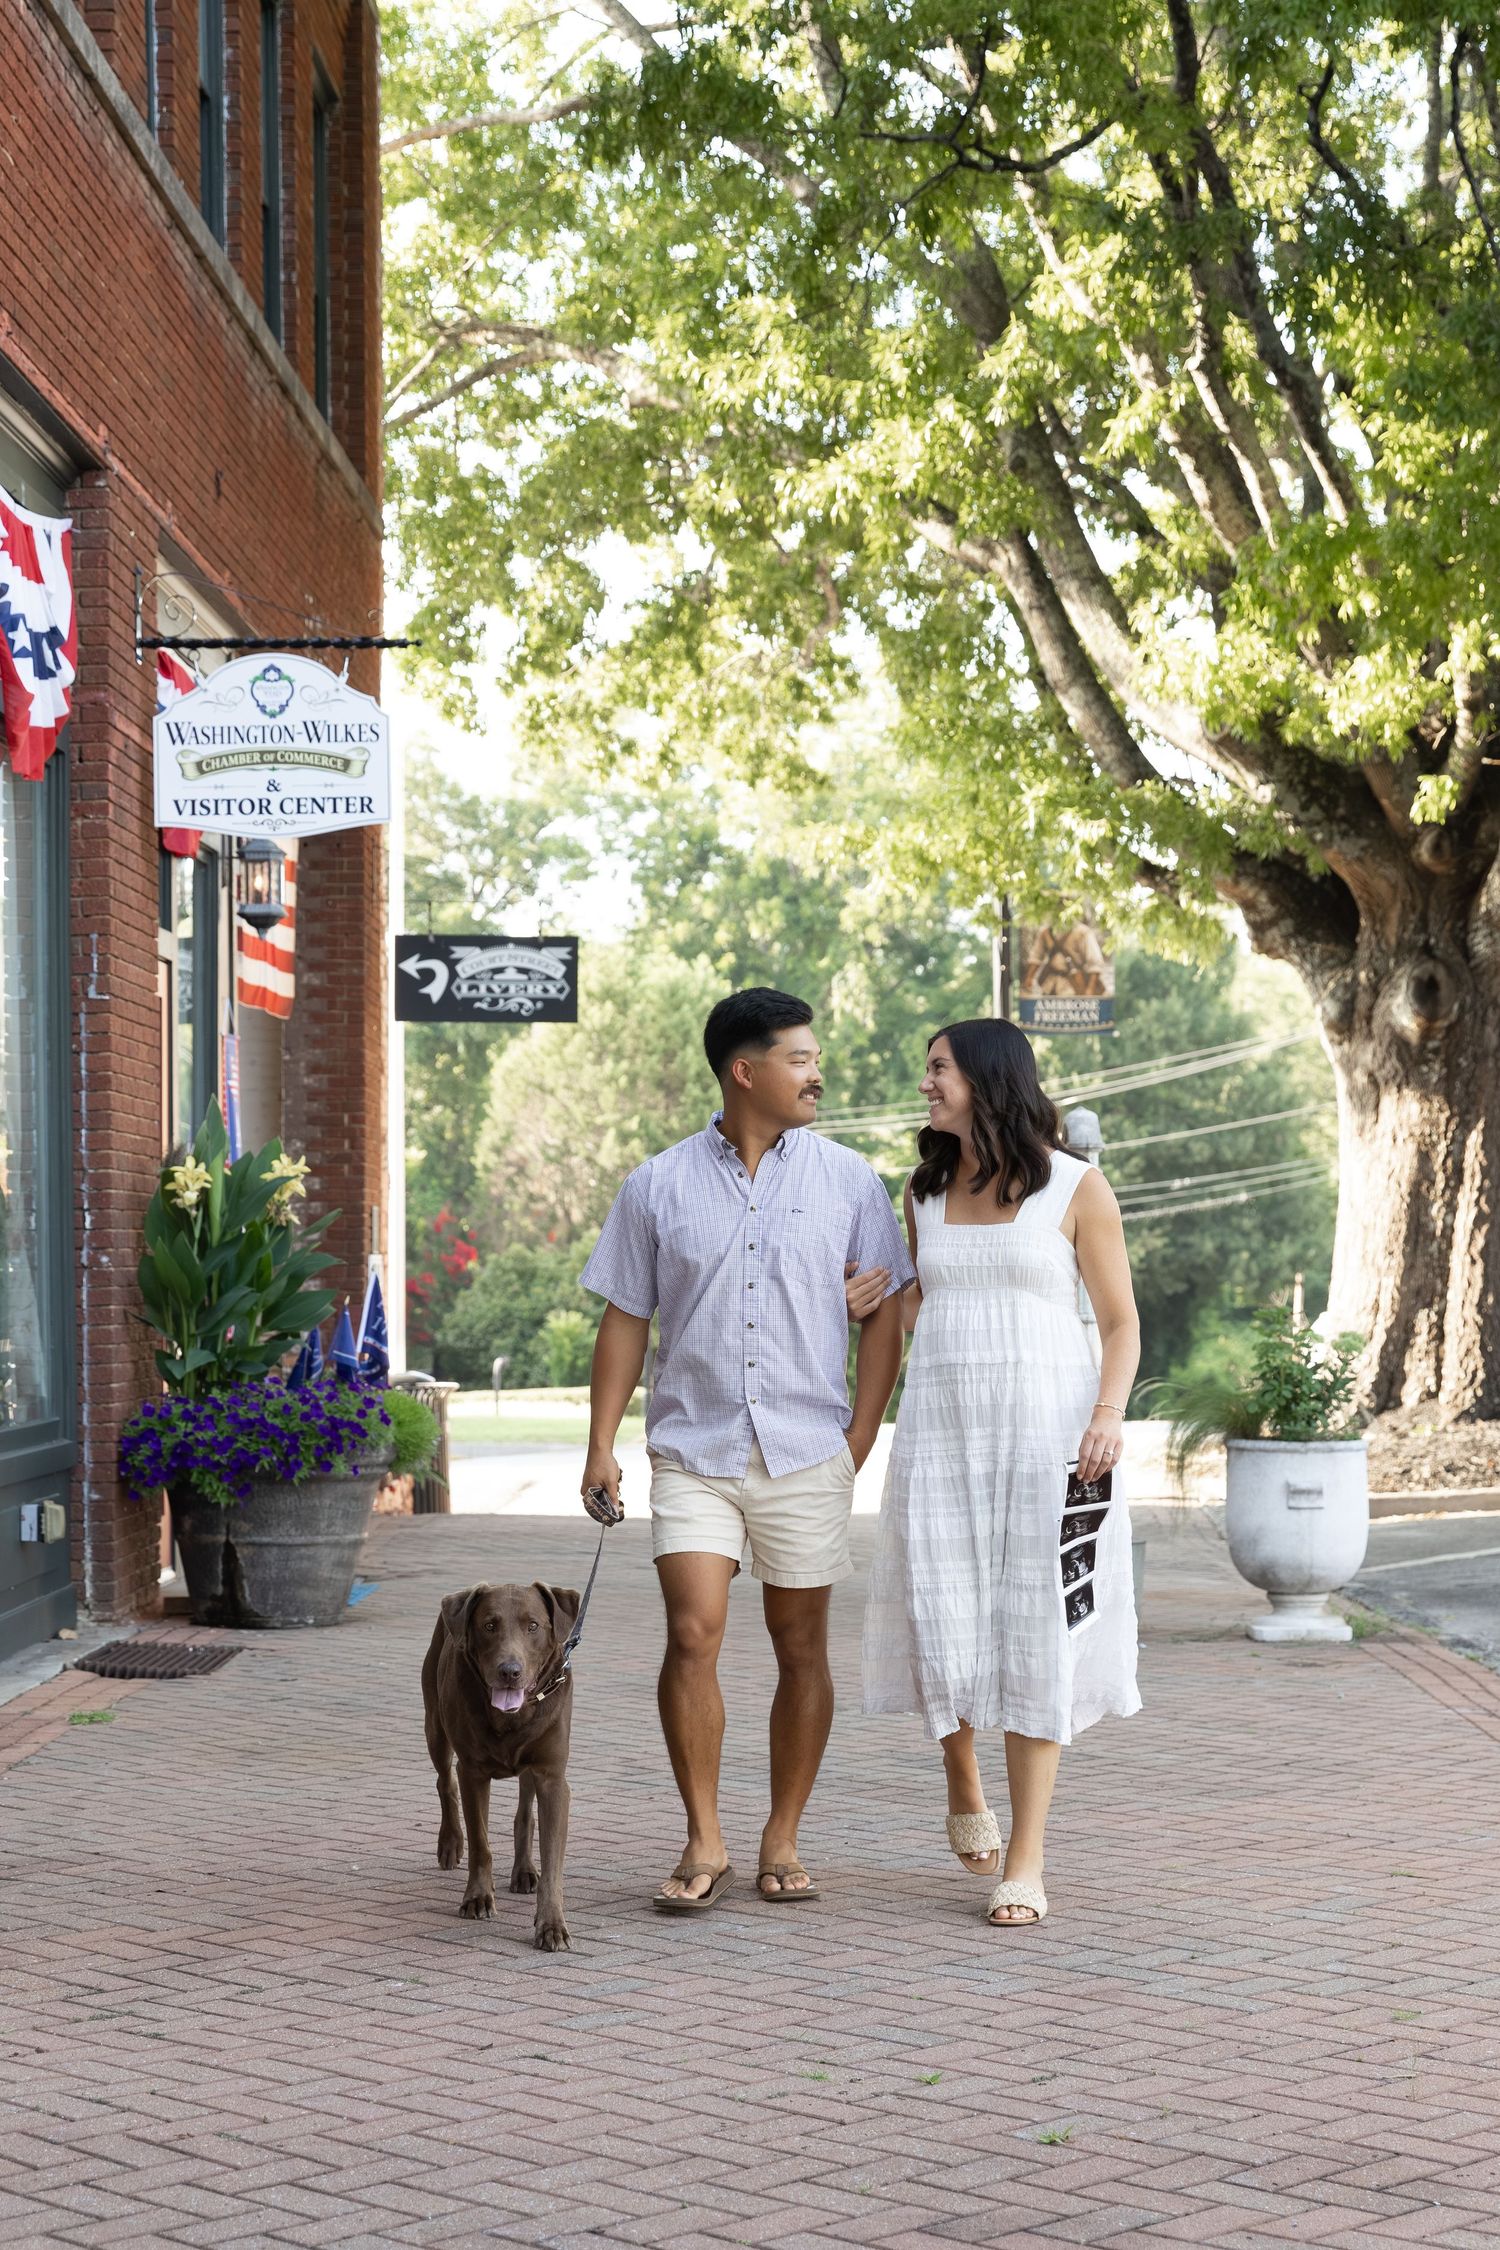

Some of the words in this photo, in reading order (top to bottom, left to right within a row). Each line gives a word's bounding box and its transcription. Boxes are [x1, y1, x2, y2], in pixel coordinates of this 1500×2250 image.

[202, 752, 261, 771] CHAMBER
[276, 751, 345, 771] COMMERCE
[266, 778, 281, 793] &
[173, 798, 274, 816] VISITOR
[279, 795, 375, 815] CENTER
[460, 982, 561, 996] LIVERY
[1034, 999, 1100, 1010] AMBROSE
[1034, 1010, 1100, 1022] FREEMAN
